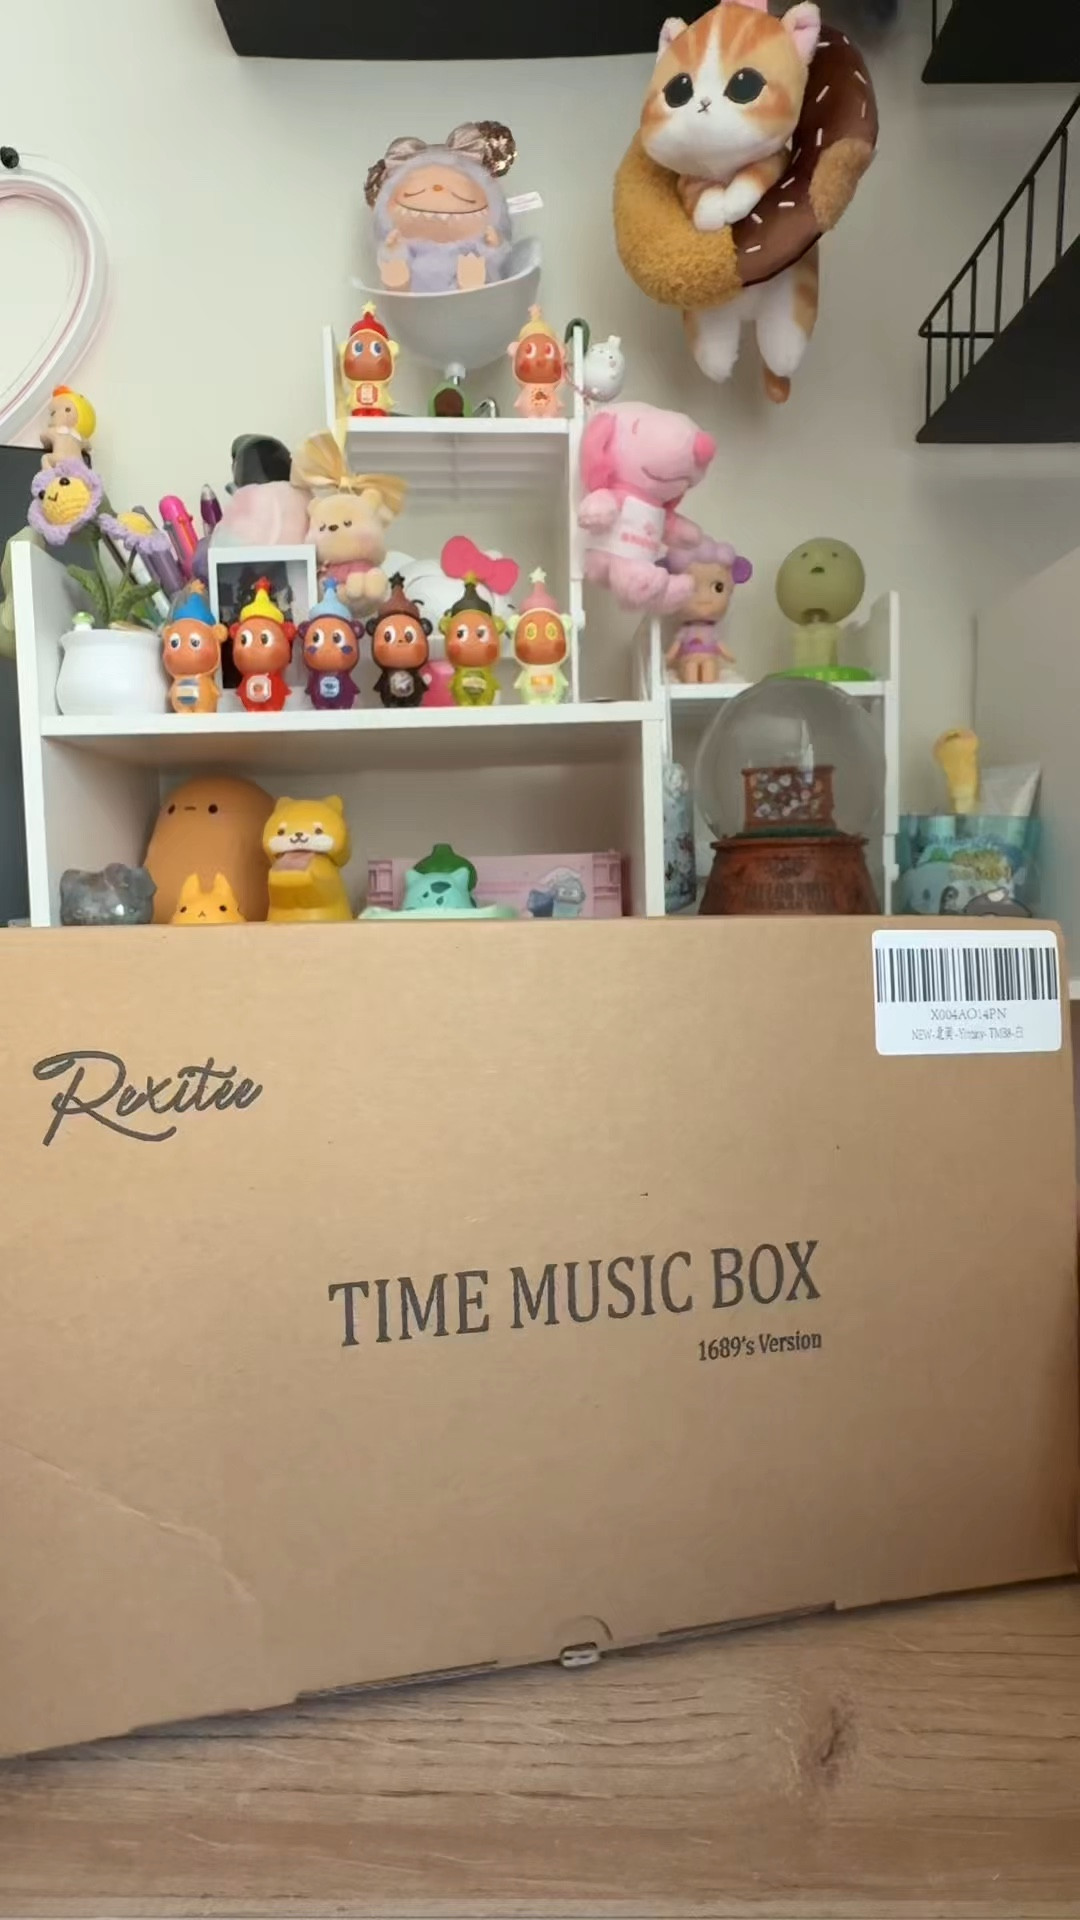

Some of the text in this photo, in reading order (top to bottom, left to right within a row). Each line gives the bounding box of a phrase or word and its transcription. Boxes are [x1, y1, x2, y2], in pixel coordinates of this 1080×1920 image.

[33, 1050, 263, 1147] Rexitee
[328, 1240, 822, 1347] TIME MUSIC BOX
[698, 1330, 822, 1362] 1689's Version
